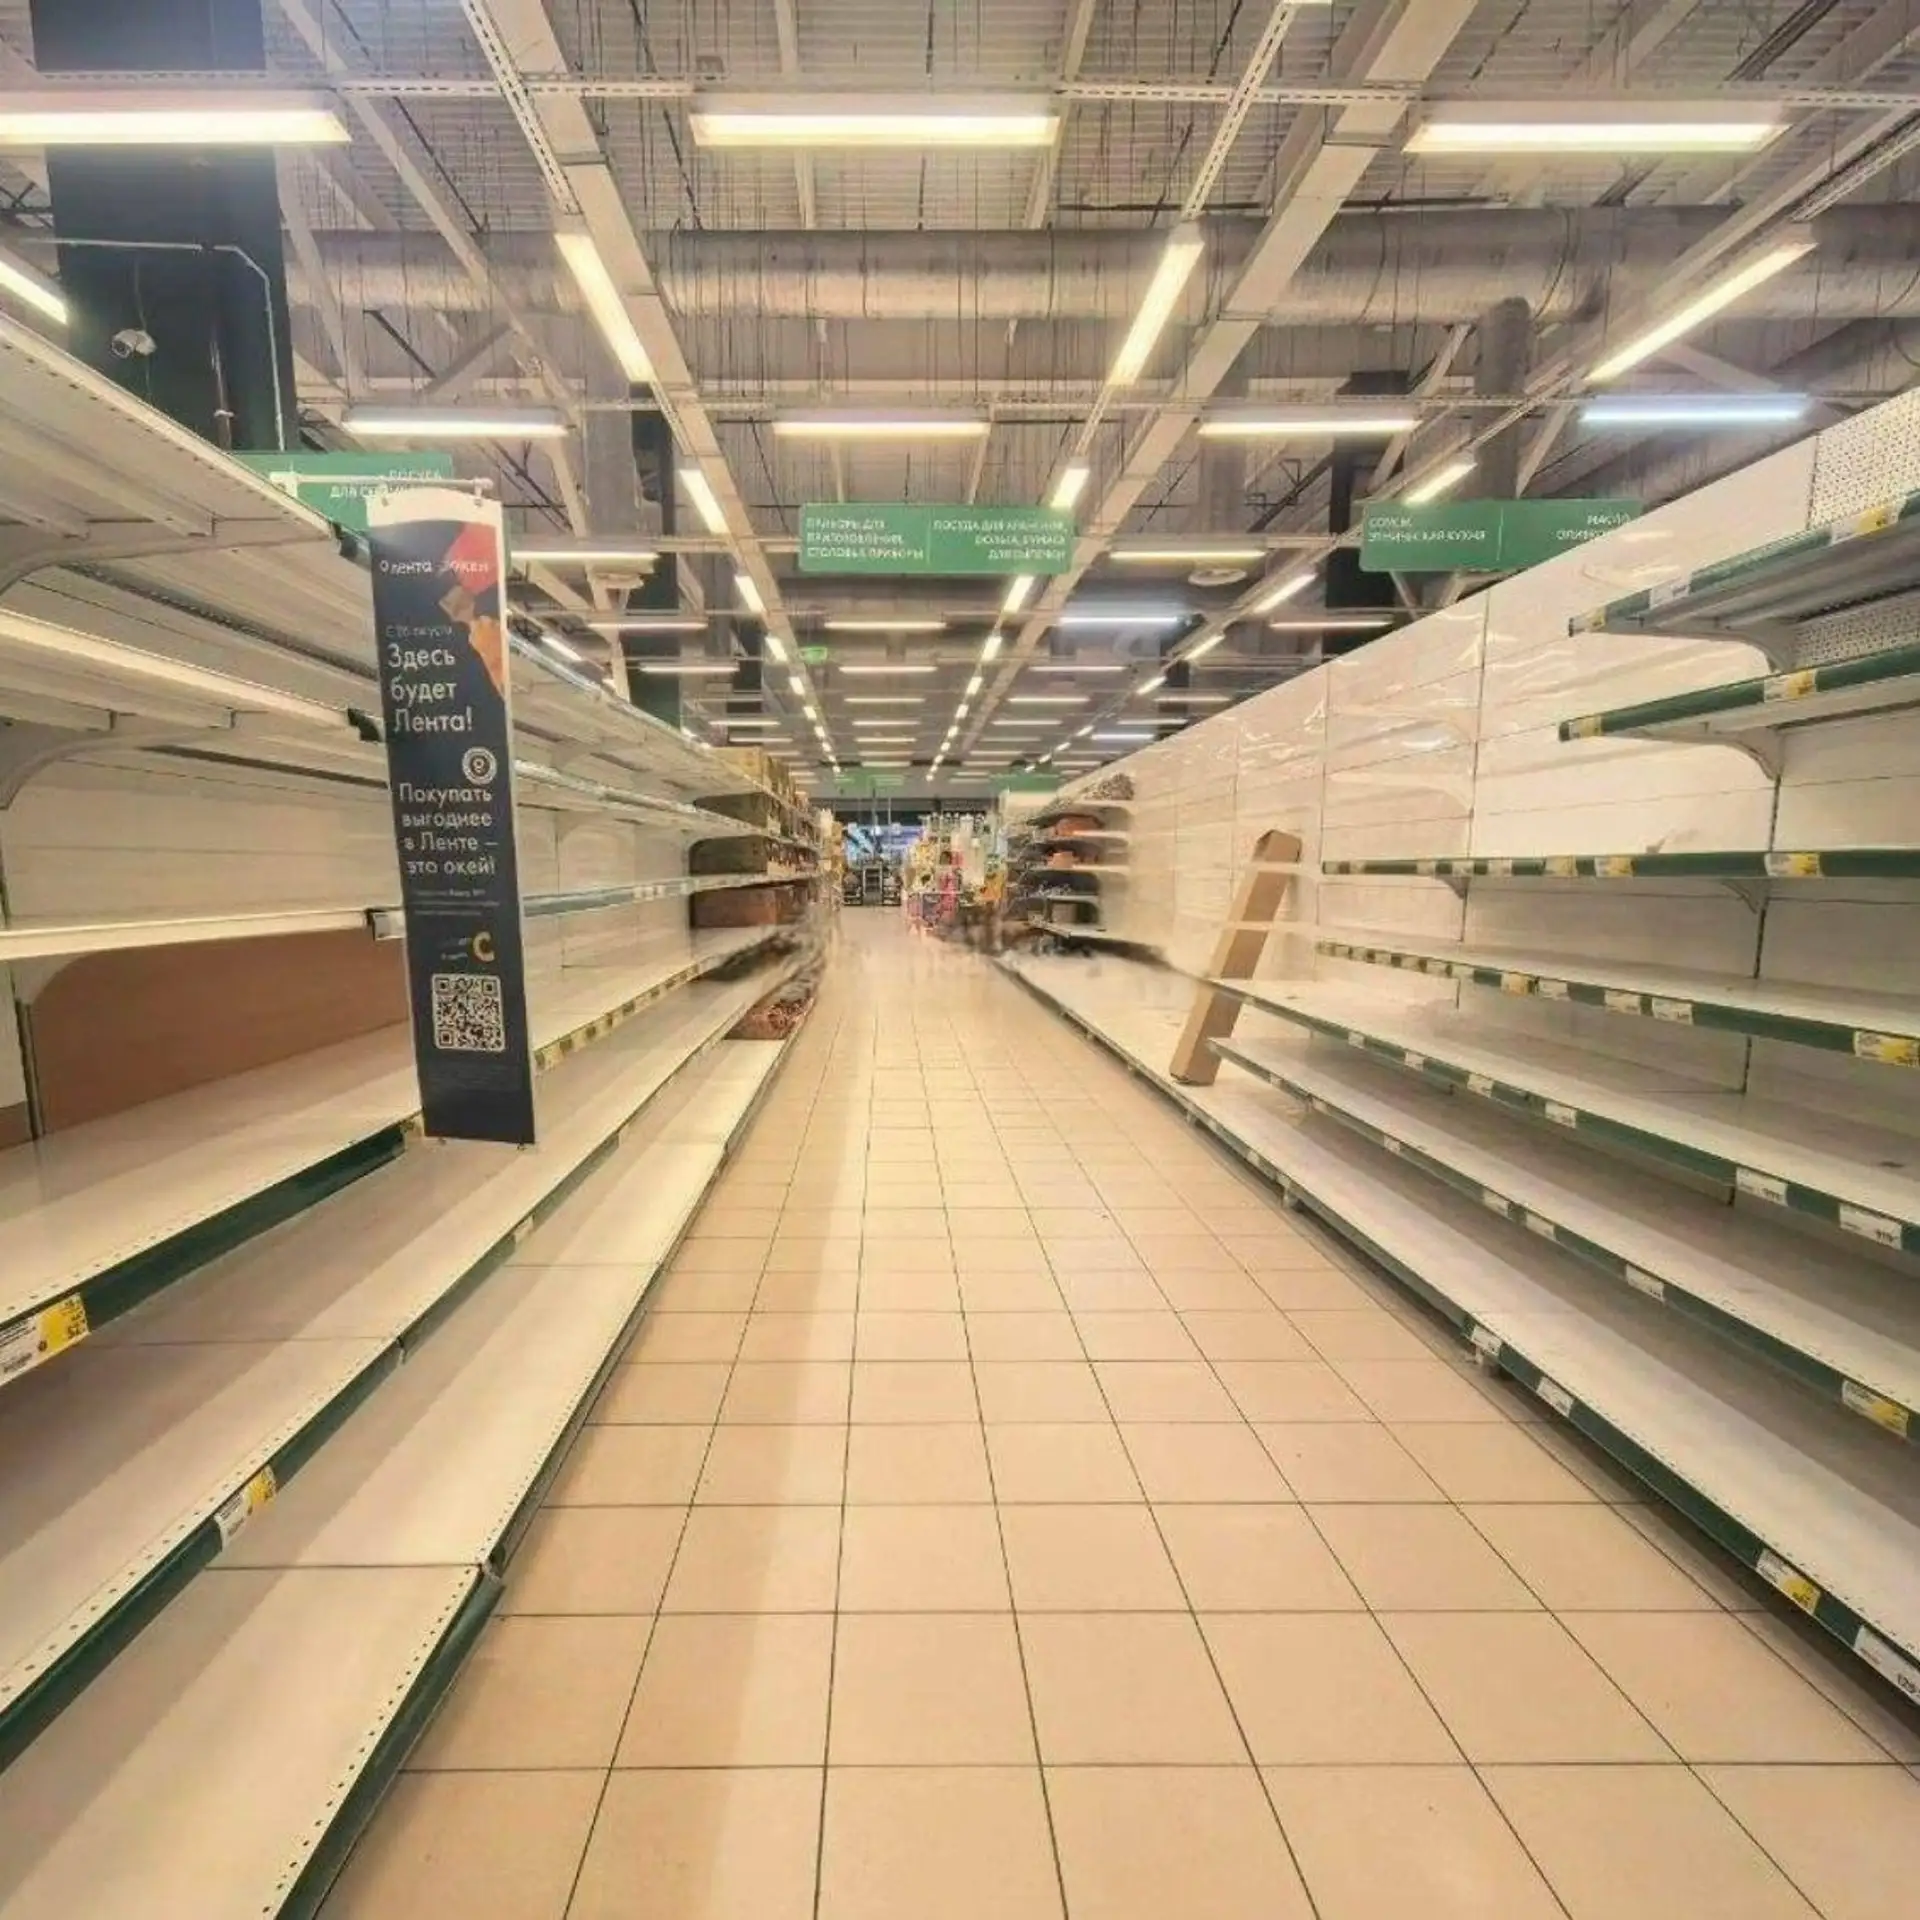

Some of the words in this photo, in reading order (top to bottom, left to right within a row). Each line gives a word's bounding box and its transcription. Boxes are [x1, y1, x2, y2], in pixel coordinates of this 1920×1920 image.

[387, 643, 456, 672] Здесь
[390, 675, 458, 707] будет
[393, 706, 473, 733] Лента!
[398, 782, 493, 808] Покупать
[401, 811, 493, 830] выгоднее
[403, 836, 416, 851] в
[420, 831, 478, 852] Ленте
[406, 860, 439, 875] это
[443, 855, 496, 876] окей!
